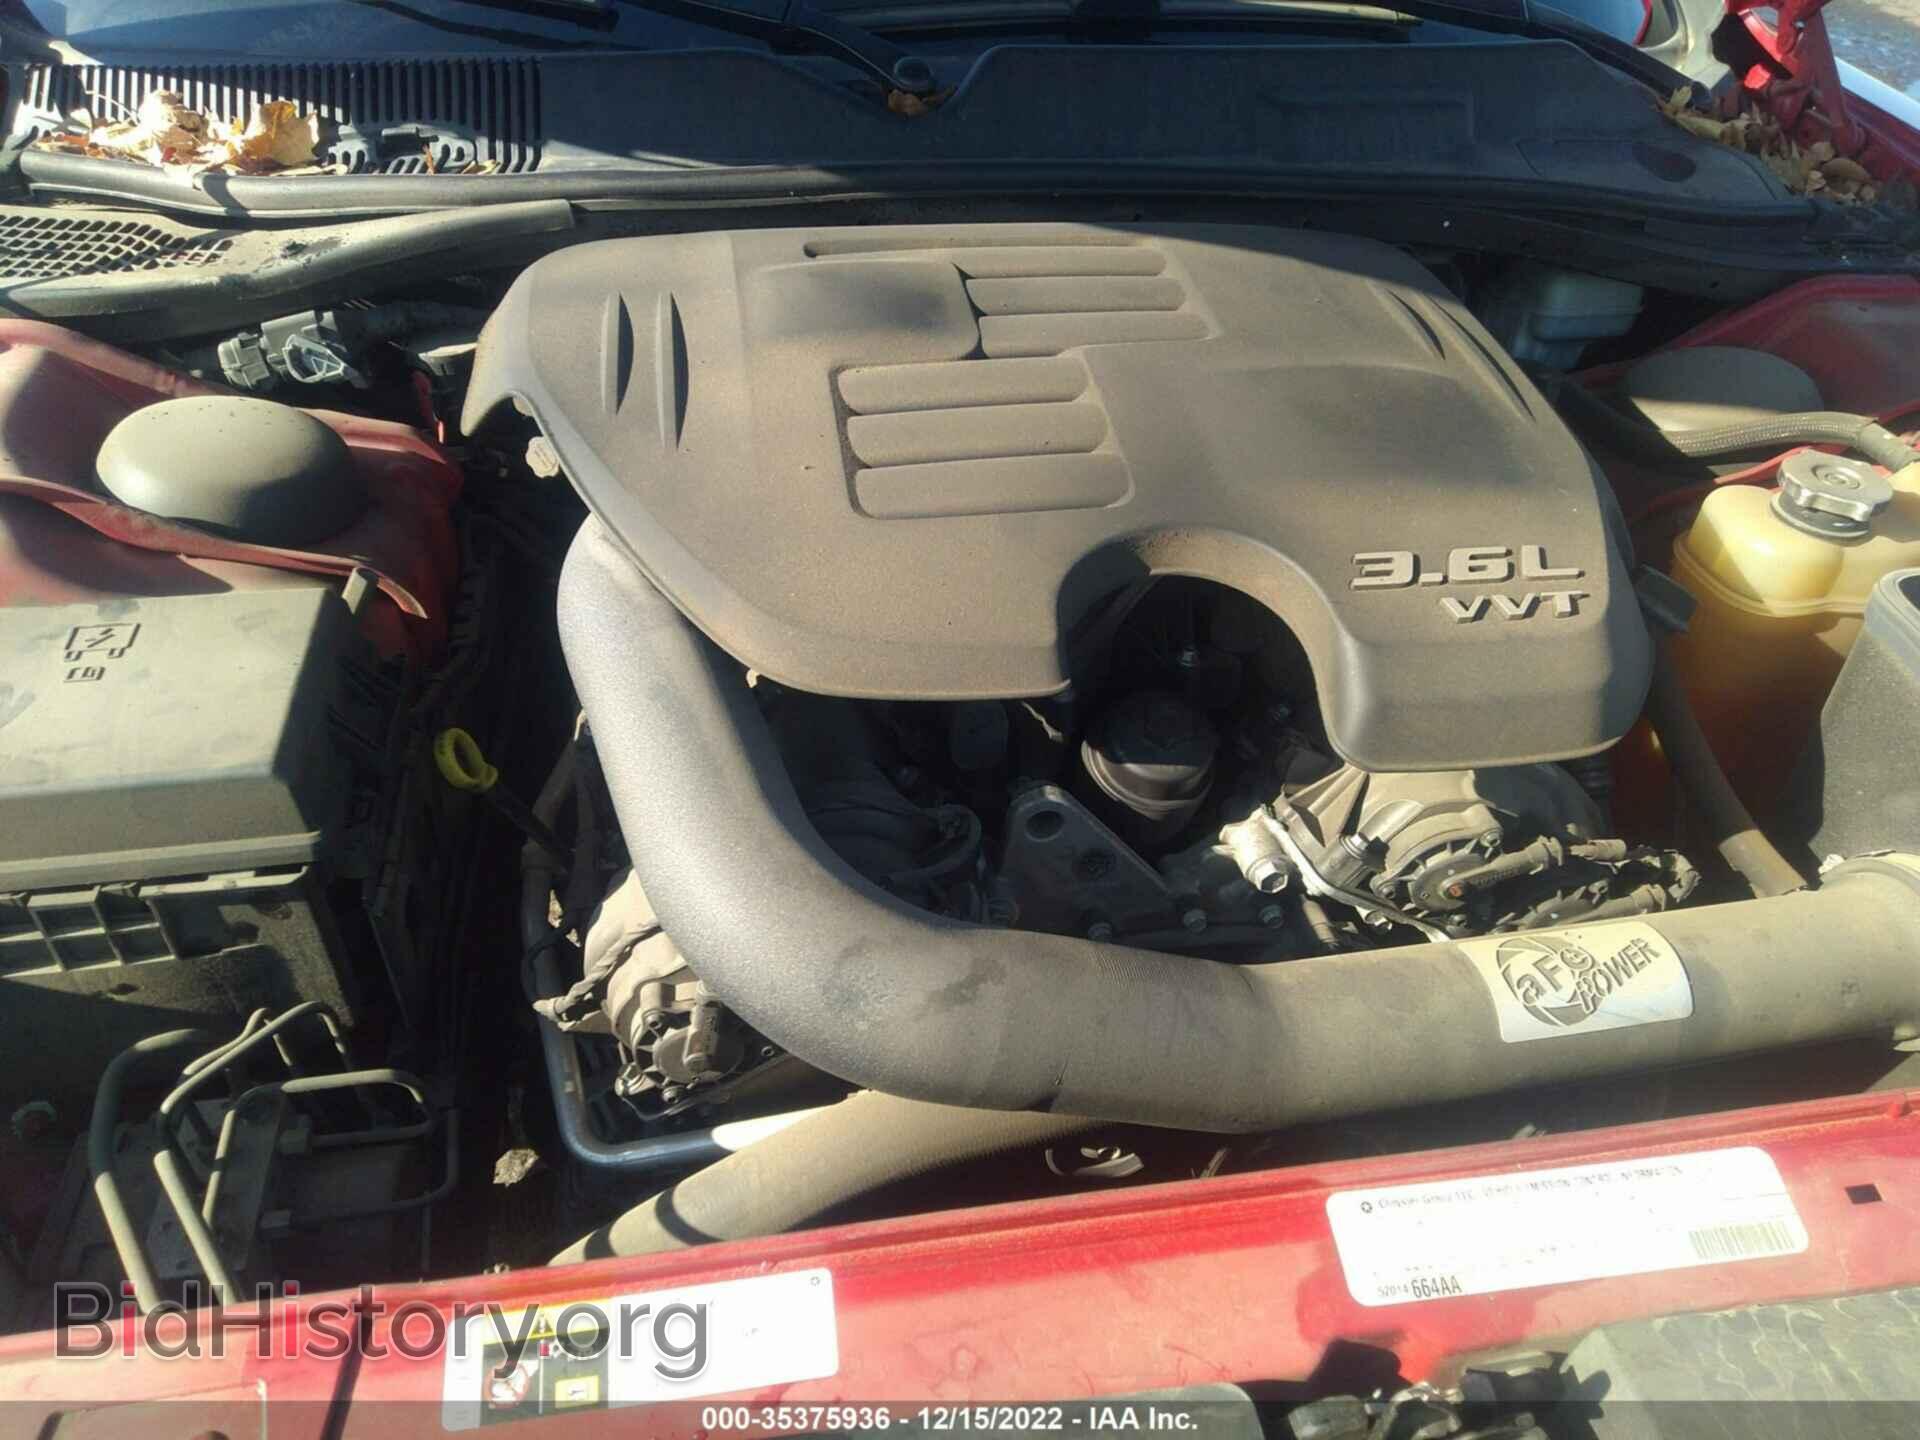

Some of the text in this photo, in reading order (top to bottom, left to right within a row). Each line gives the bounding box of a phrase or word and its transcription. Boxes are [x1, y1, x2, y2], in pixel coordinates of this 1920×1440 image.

[1350, 545, 1586, 590] 3.6L
[1439, 590, 1590, 624] VVT
[1575, 937, 1661, 1014] POWER
[1410, 1275, 1463, 1299] 664AA
